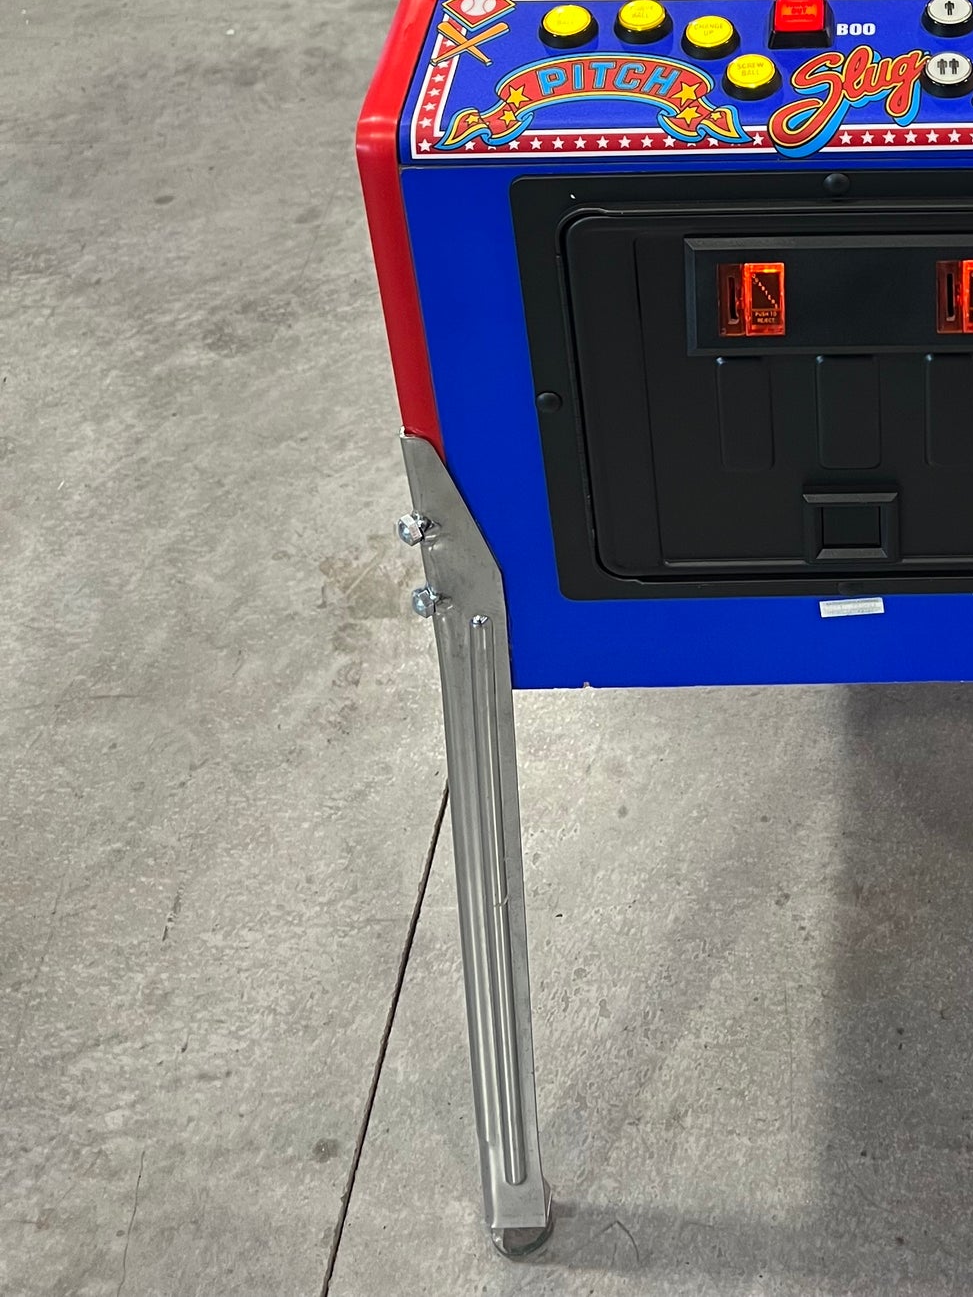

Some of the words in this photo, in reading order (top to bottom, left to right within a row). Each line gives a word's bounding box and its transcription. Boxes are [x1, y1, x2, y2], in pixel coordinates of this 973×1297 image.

[693, 22, 724, 31] CHANGE
[836, 23, 876, 36] BOO
[703, 29, 715, 37] UP
[737, 61, 765, 70] SCREW
[741, 68, 760, 77] BALL
[536, 59, 683, 97] PITCH
[767, 45, 931, 154] Slug
